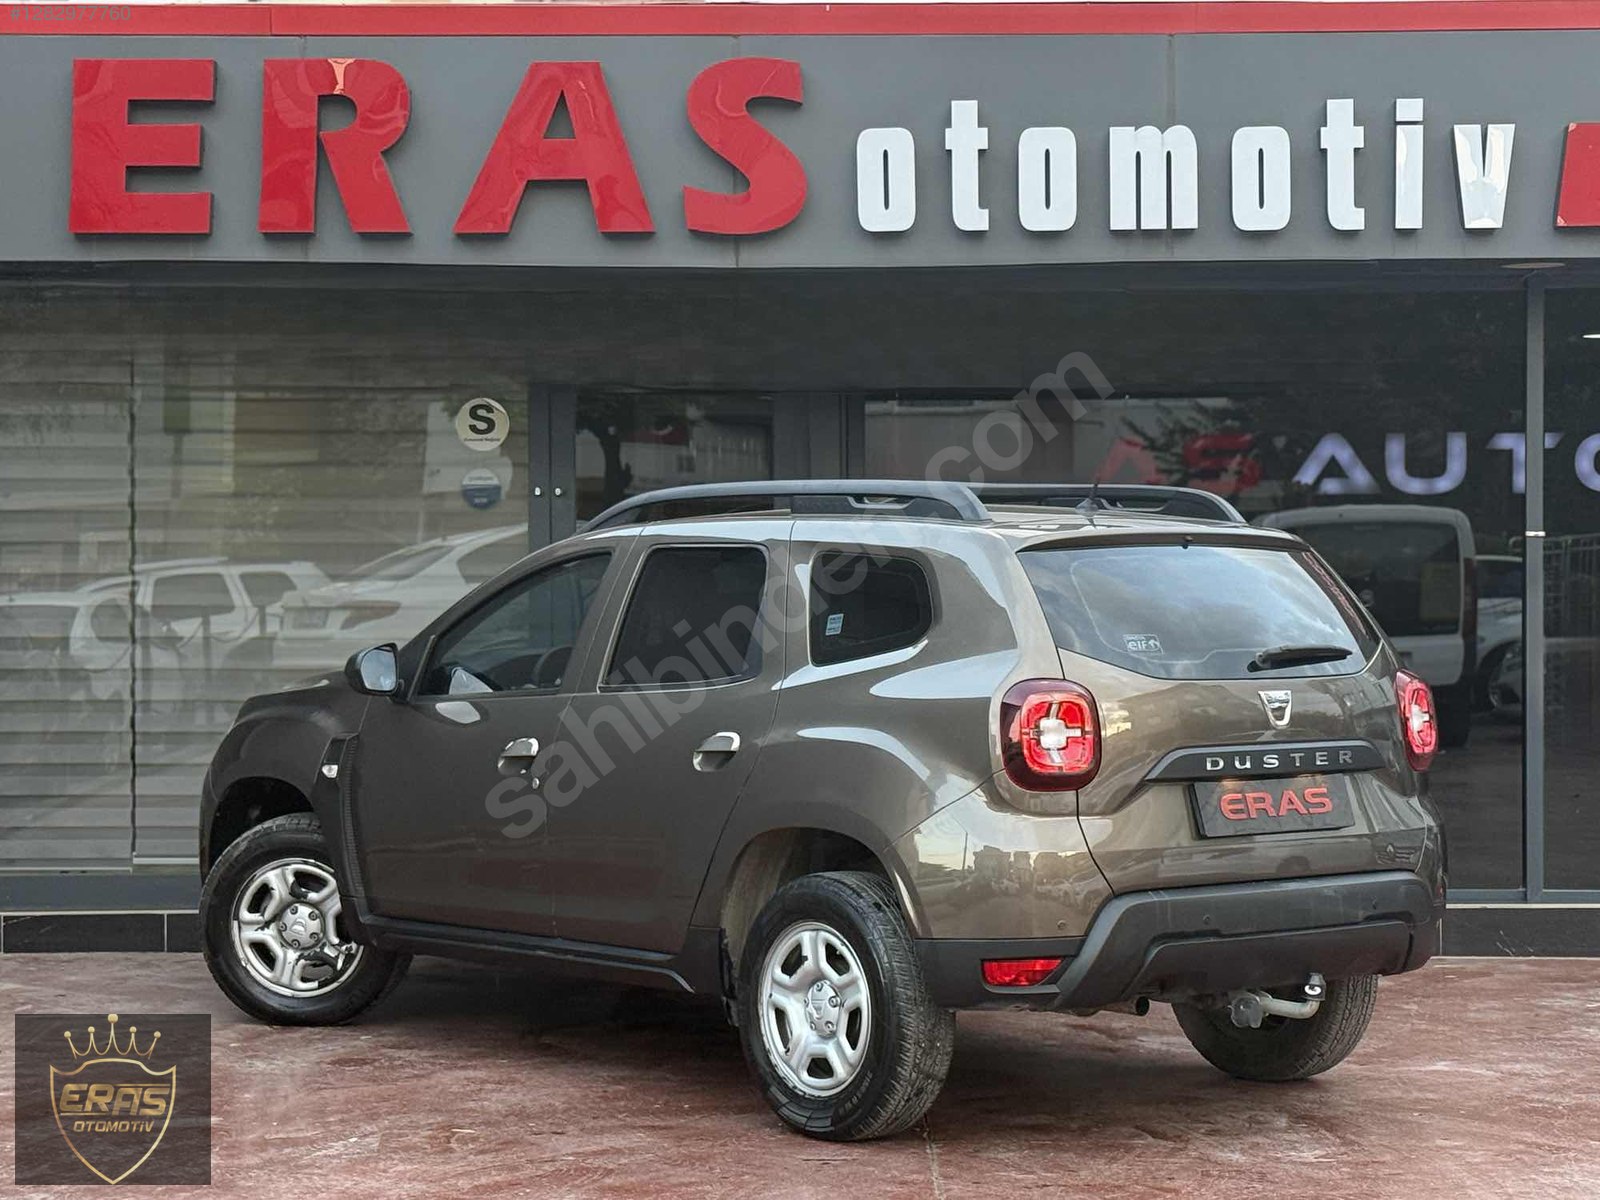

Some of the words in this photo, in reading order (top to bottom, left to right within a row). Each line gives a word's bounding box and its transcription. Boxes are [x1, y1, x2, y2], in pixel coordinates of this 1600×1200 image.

[68, 57, 808, 235] ERAS
[856, 97, 1517, 232] otomotiv
[469, 404, 495, 435] S
[1206, 750, 1353, 771] DUSTER
[1219, 787, 1334, 820] ERAS
